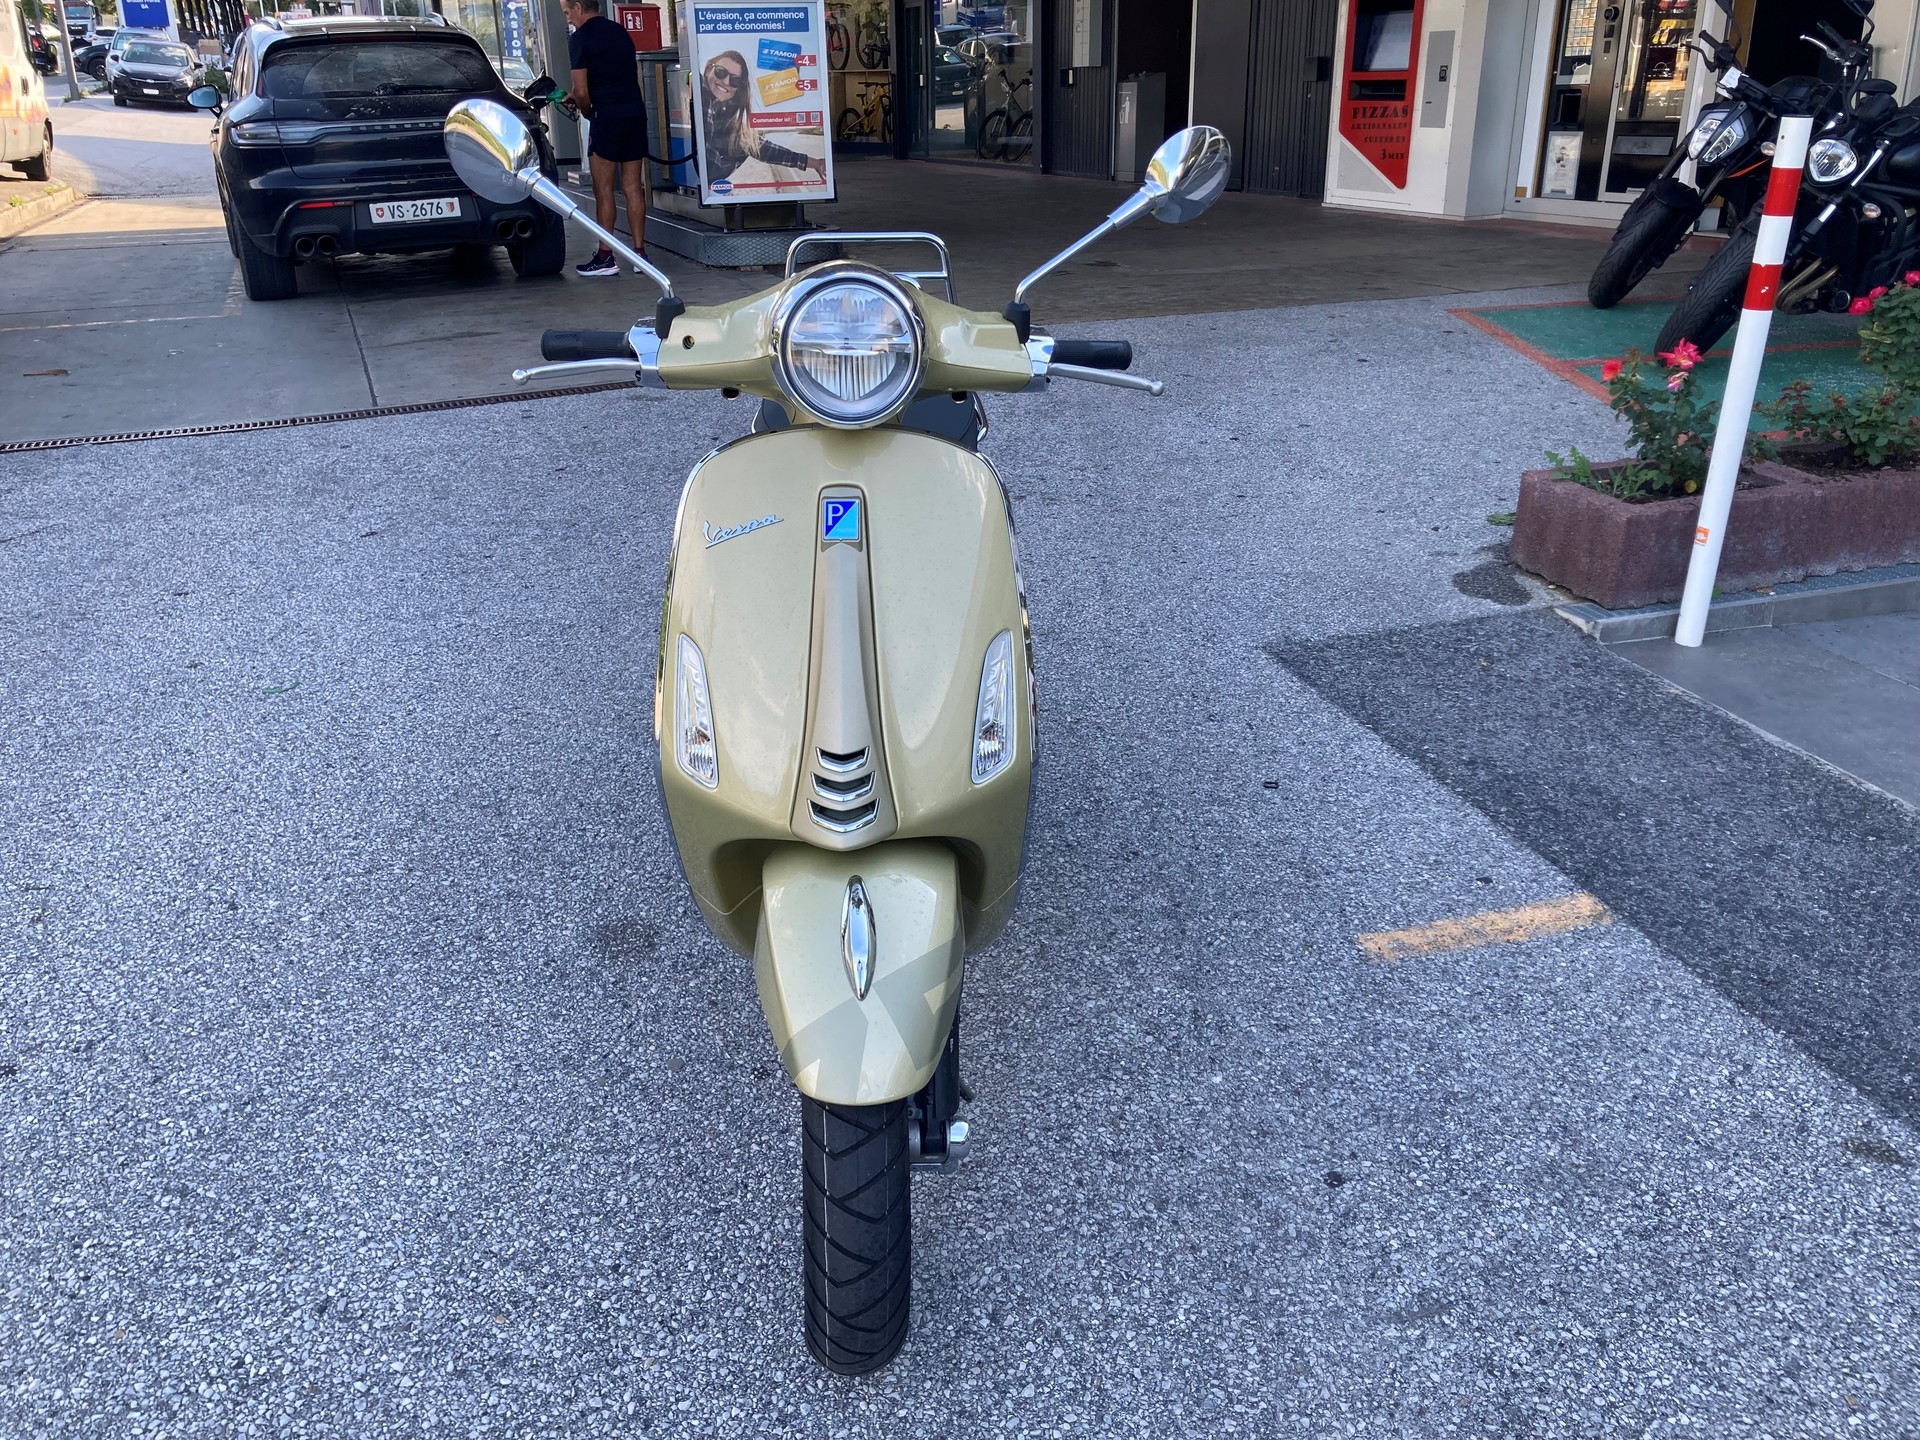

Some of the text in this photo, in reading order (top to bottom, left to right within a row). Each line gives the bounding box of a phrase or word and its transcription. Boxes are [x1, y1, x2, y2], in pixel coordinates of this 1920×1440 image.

[698, 11, 805, 21] L'évasion, ça commence
[700, 23, 714, 33] par
[716, 22, 732, 31] des
[1352, 105, 1409, 119] PIZZAS
[702, 514, 784, 549] Vespa
